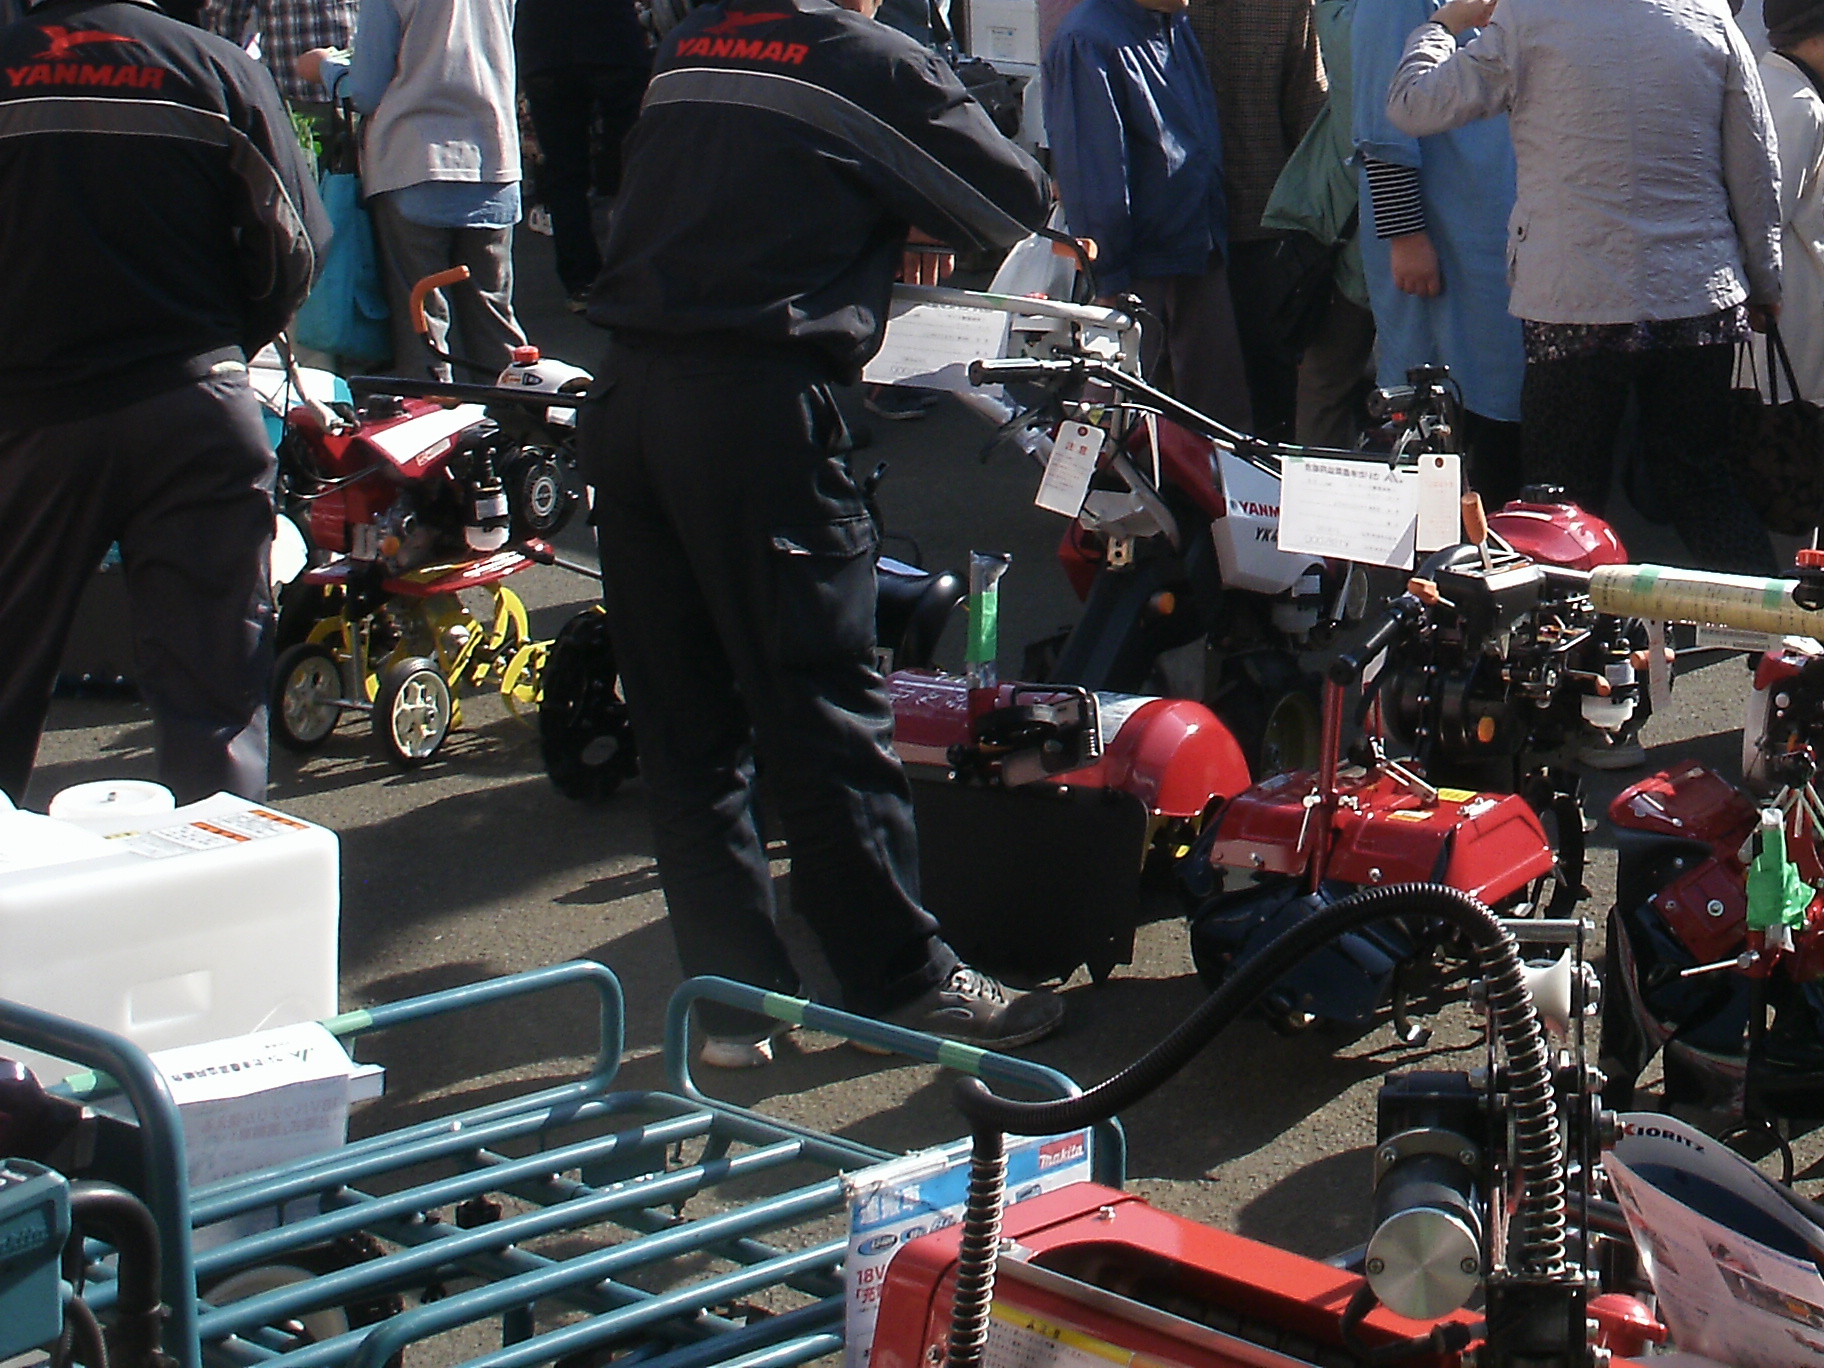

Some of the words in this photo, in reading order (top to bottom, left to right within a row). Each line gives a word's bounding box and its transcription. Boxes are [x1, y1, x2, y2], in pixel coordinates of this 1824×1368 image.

[675, 37, 811, 64] YANMAR
[5, 63, 168, 90] YANMAR
[1623, 1123, 1706, 1153] KIORITZ
[857, 1264, 886, 1285] 18V
